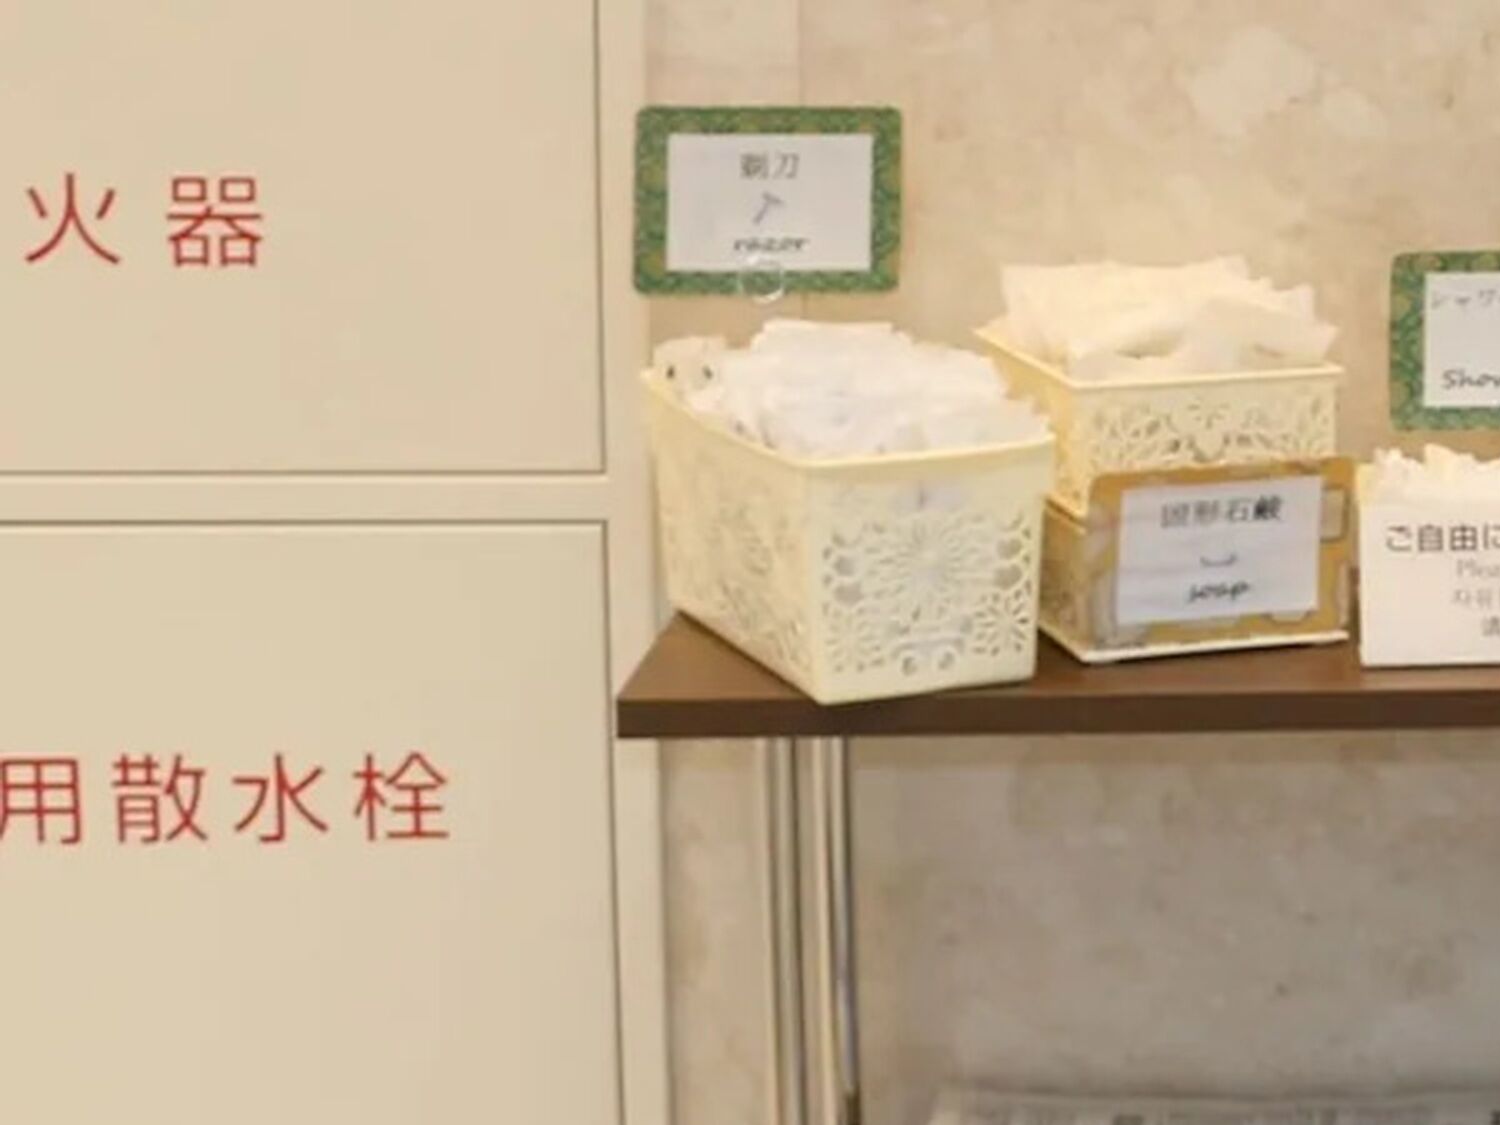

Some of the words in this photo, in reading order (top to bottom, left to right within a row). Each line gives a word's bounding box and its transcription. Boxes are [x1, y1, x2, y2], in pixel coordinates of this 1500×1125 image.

[25, 172, 264, 269] 火器
[0, 752, 450, 846] 用散水栓
